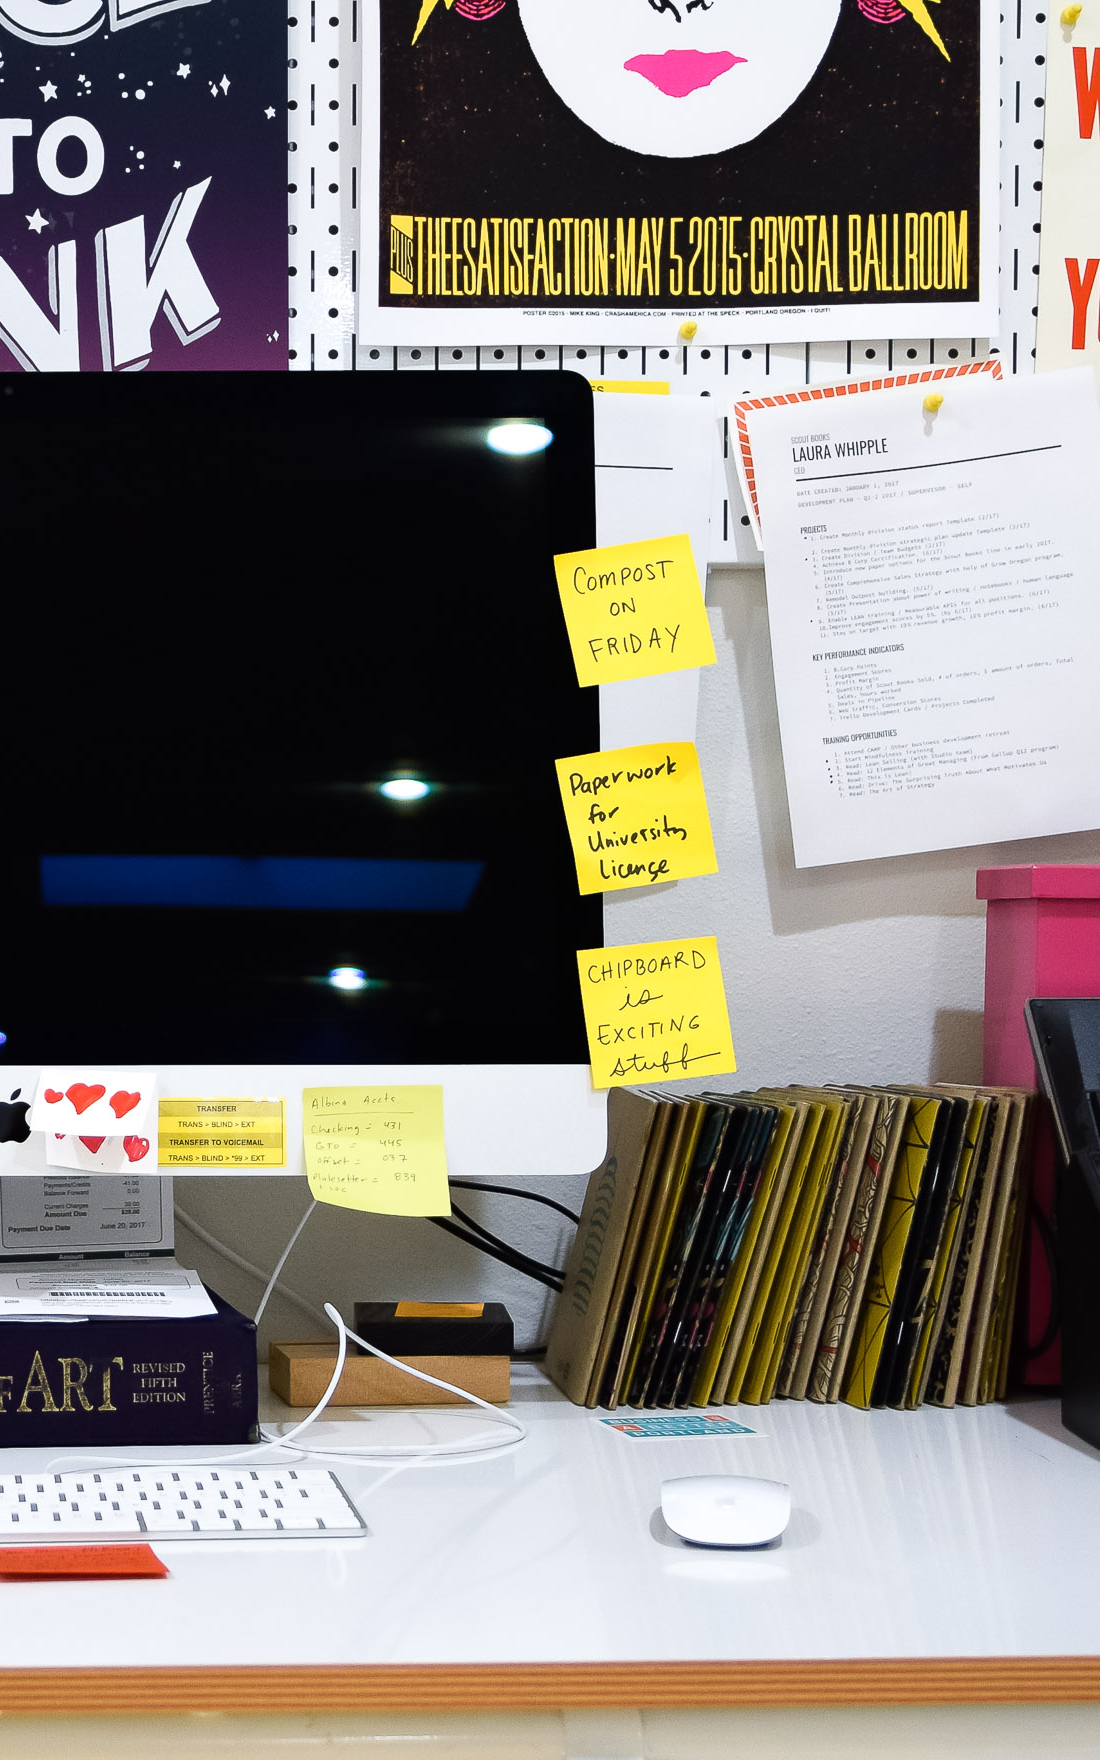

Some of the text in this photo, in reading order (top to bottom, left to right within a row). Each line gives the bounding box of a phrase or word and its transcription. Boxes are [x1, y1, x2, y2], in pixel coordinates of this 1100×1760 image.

[390, 226, 414, 285] PLUS
[616, 216, 664, 296] MAY
[669, 216, 684, 296] 5
[688, 215, 742, 296] 2015
[750, 213, 843, 295] CRYSTAL
[848, 209, 968, 292] BALLROOM
[790, 433, 831, 445] SCOUT BOOKS
[792, 438, 889, 463] LAURA WHIPPLE
[793, 466, 806, 475] CEO
[800, 525, 828, 535] PROJECTS
[573, 560, 674, 595] COMPOST
[610, 597, 636, 616] ON
[588, 624, 680, 663] FRIDAY
[812, 643, 905, 661] KEY PERFORMANCE INDICATORS
[822, 729, 898, 745] TRAINING OPPORTUNITIES
[569, 755, 677, 796] Paperwork
[588, 803, 620, 824] for
[588, 814, 687, 852] University
[587, 949, 706, 983] CHIPBOARD
[618, 986, 664, 1011] is
[597, 1014, 700, 1045] EXCITING
[196, 1105, 237, 1113] TRANSFER
[311, 1096, 347, 1110] Albina
[310, 1121, 401, 1136] Checking 431
[315, 1138, 403, 1150] GTO 445
[168, 1154, 266, 1162] TRANS BLIND EXT
[394, 1172, 416, 1182] 839
[8, 1226, 39, 1234] Payment
[132, 1362, 186, 1374] REVISED
[16, 1349, 123, 1412] ART
[141, 1377, 177, 1388] FIFTH
[132, 1391, 186, 1403] EDITION
